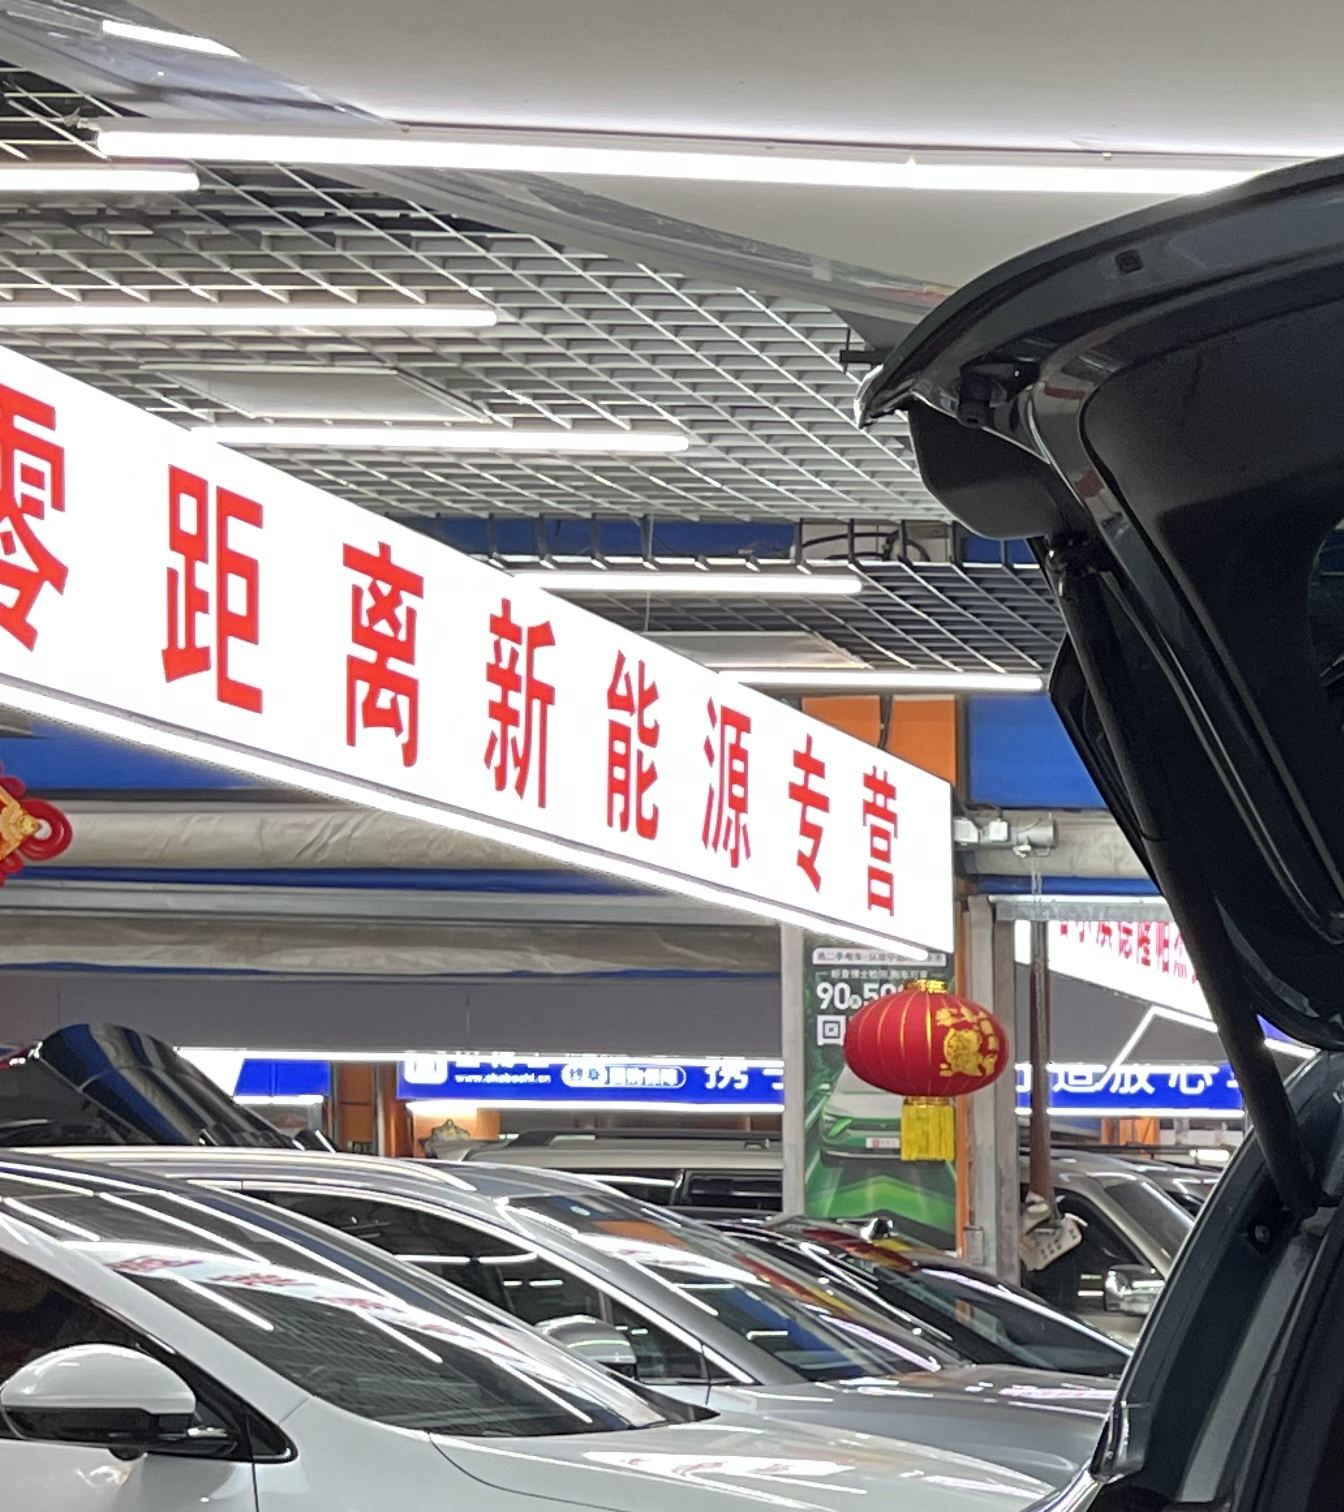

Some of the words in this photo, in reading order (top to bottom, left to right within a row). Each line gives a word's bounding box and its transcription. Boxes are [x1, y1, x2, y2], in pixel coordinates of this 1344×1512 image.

[0, 384, 898, 917] 零距离新能源专营
